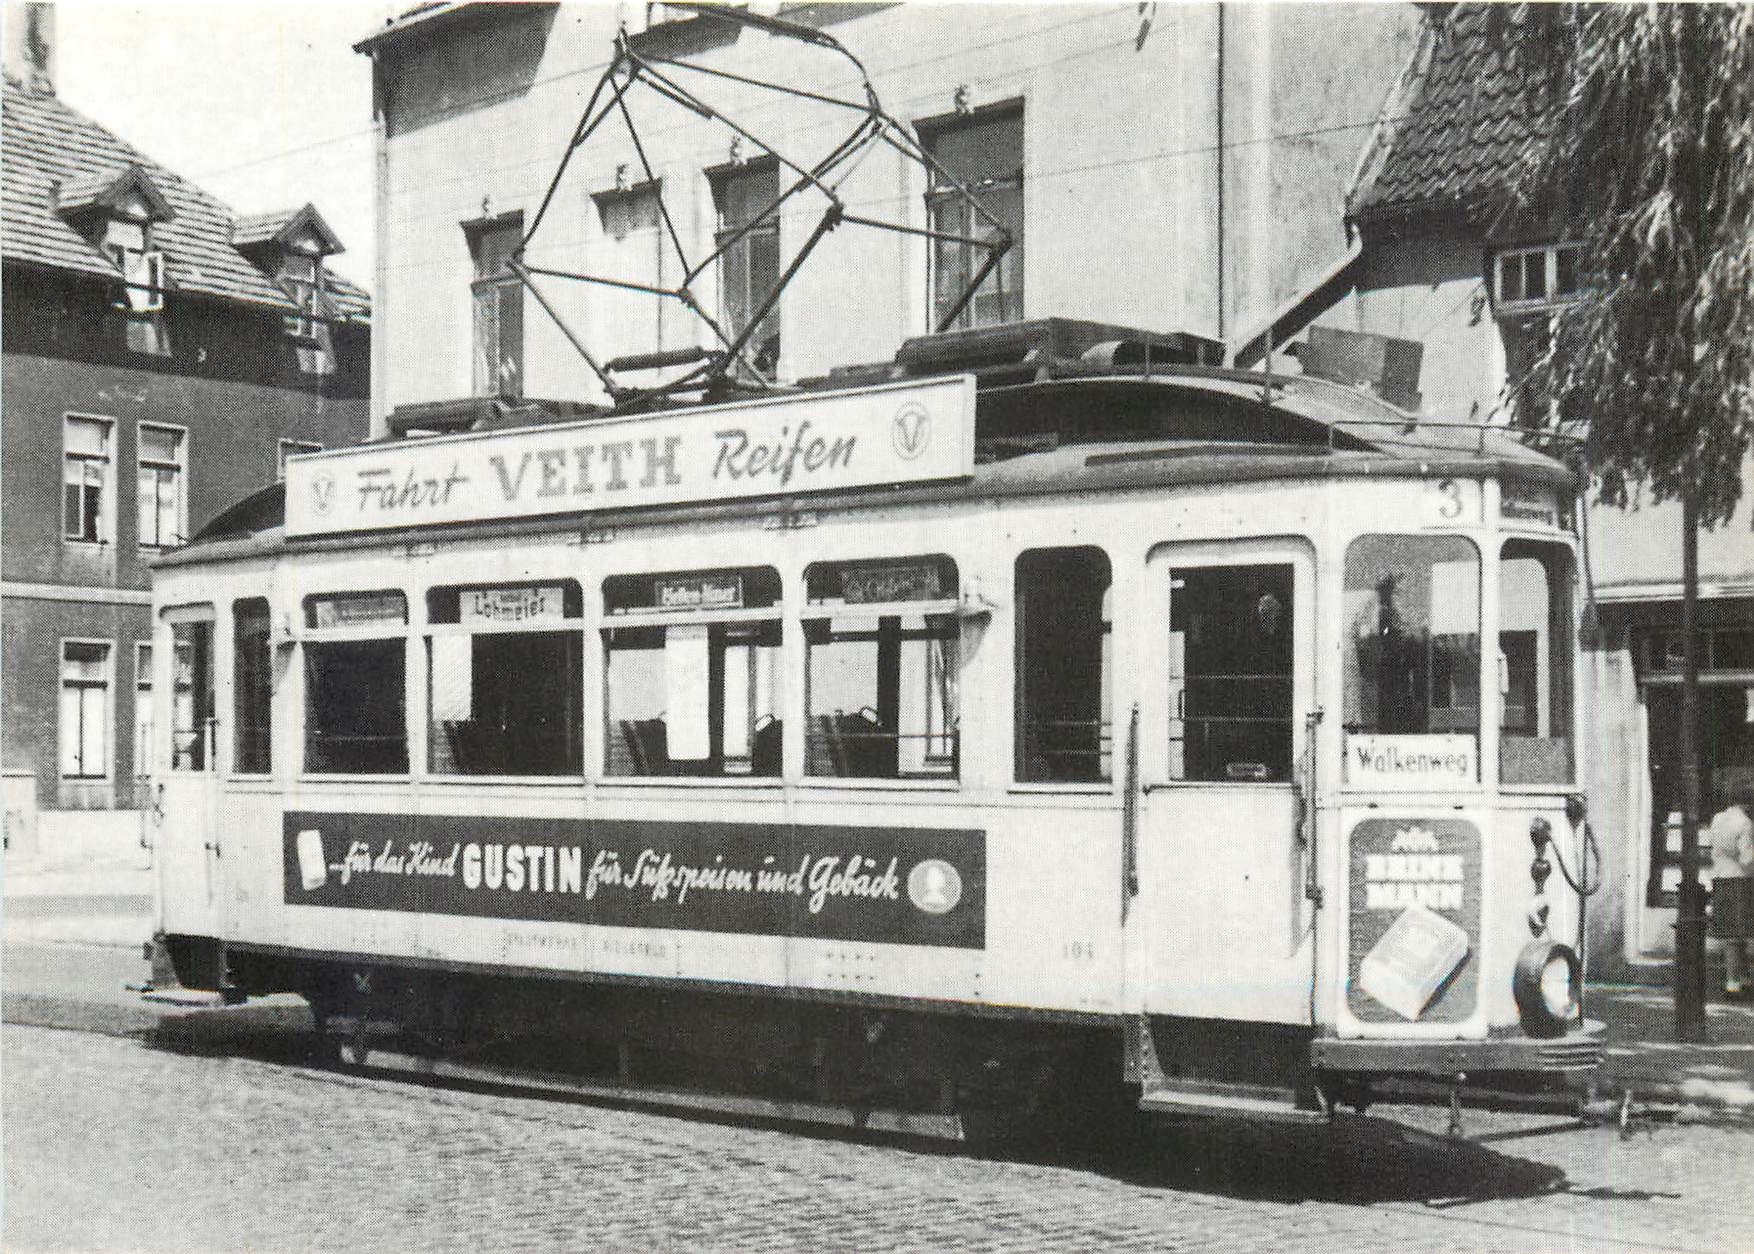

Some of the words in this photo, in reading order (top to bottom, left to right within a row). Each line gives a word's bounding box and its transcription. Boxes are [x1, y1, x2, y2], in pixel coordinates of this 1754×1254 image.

[357, 460, 471, 511] Fahrt
[489, 436, 682, 501] VEITH
[713, 420, 857, 486] Reifen
[1438, 479, 1463, 519] 3
[1356, 744, 1468, 777] Walkenweg
[406, 841, 461, 877] Kind
[462, 842, 582, 893] GUSTIN
[585, 849, 622, 901] für
[809, 853, 899, 914] Gebäck
